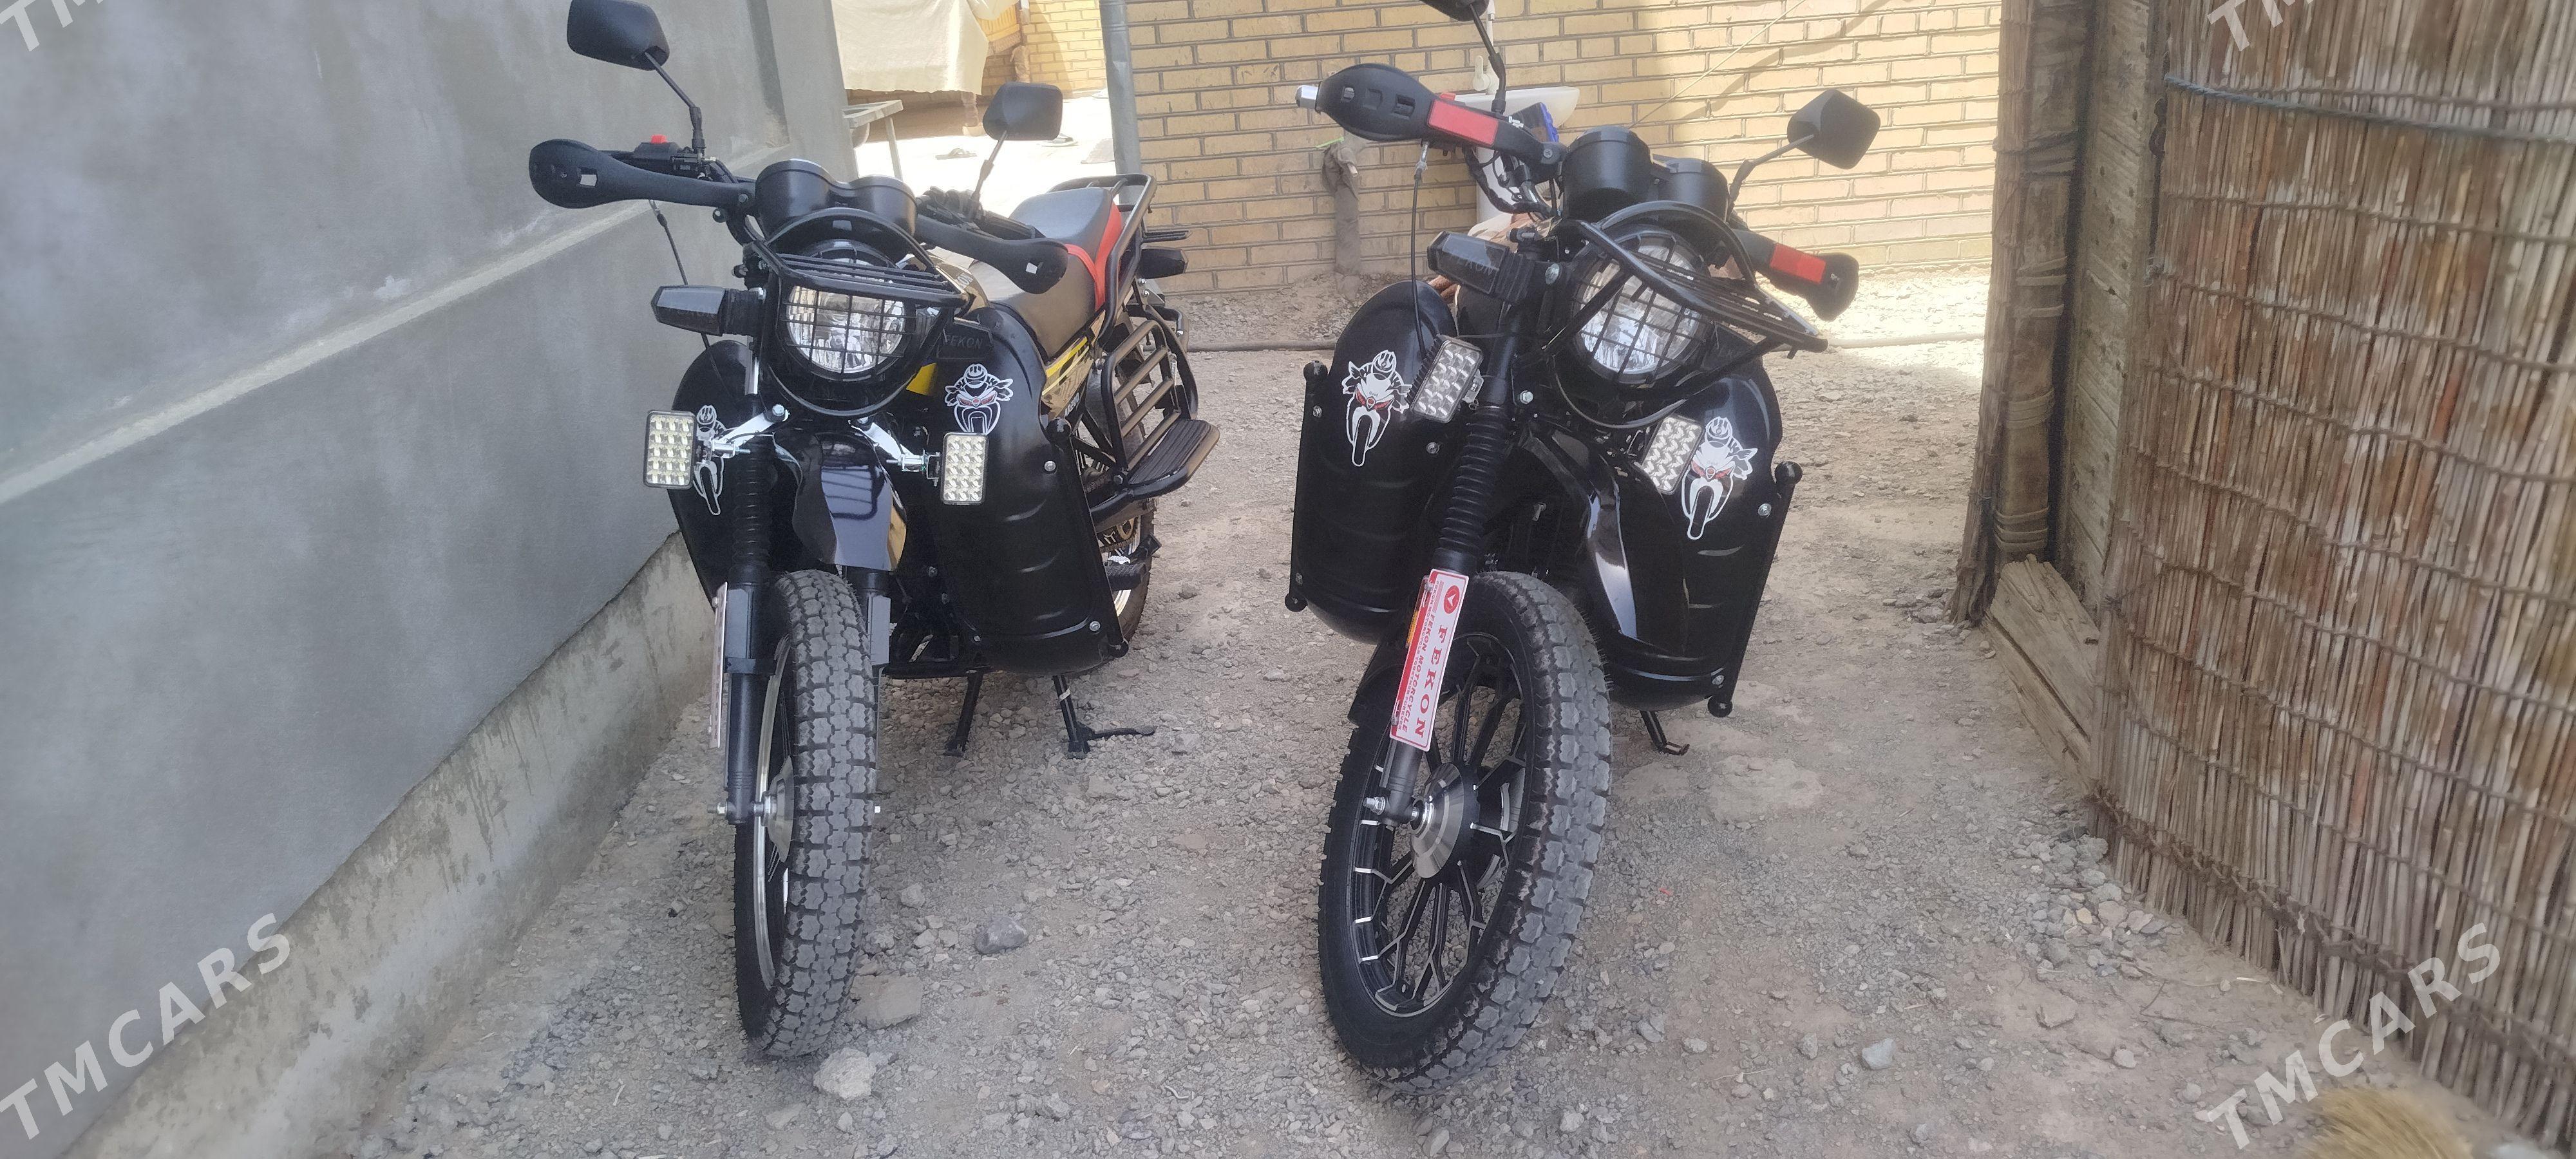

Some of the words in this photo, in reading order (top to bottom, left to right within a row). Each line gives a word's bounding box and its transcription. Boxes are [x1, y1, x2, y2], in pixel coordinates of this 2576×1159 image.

[1421, 614, 1435, 652] FEKON
[1402, 655, 1424, 733] MOTORCYCLE
[1415, 625, 1448, 738] FEKON
